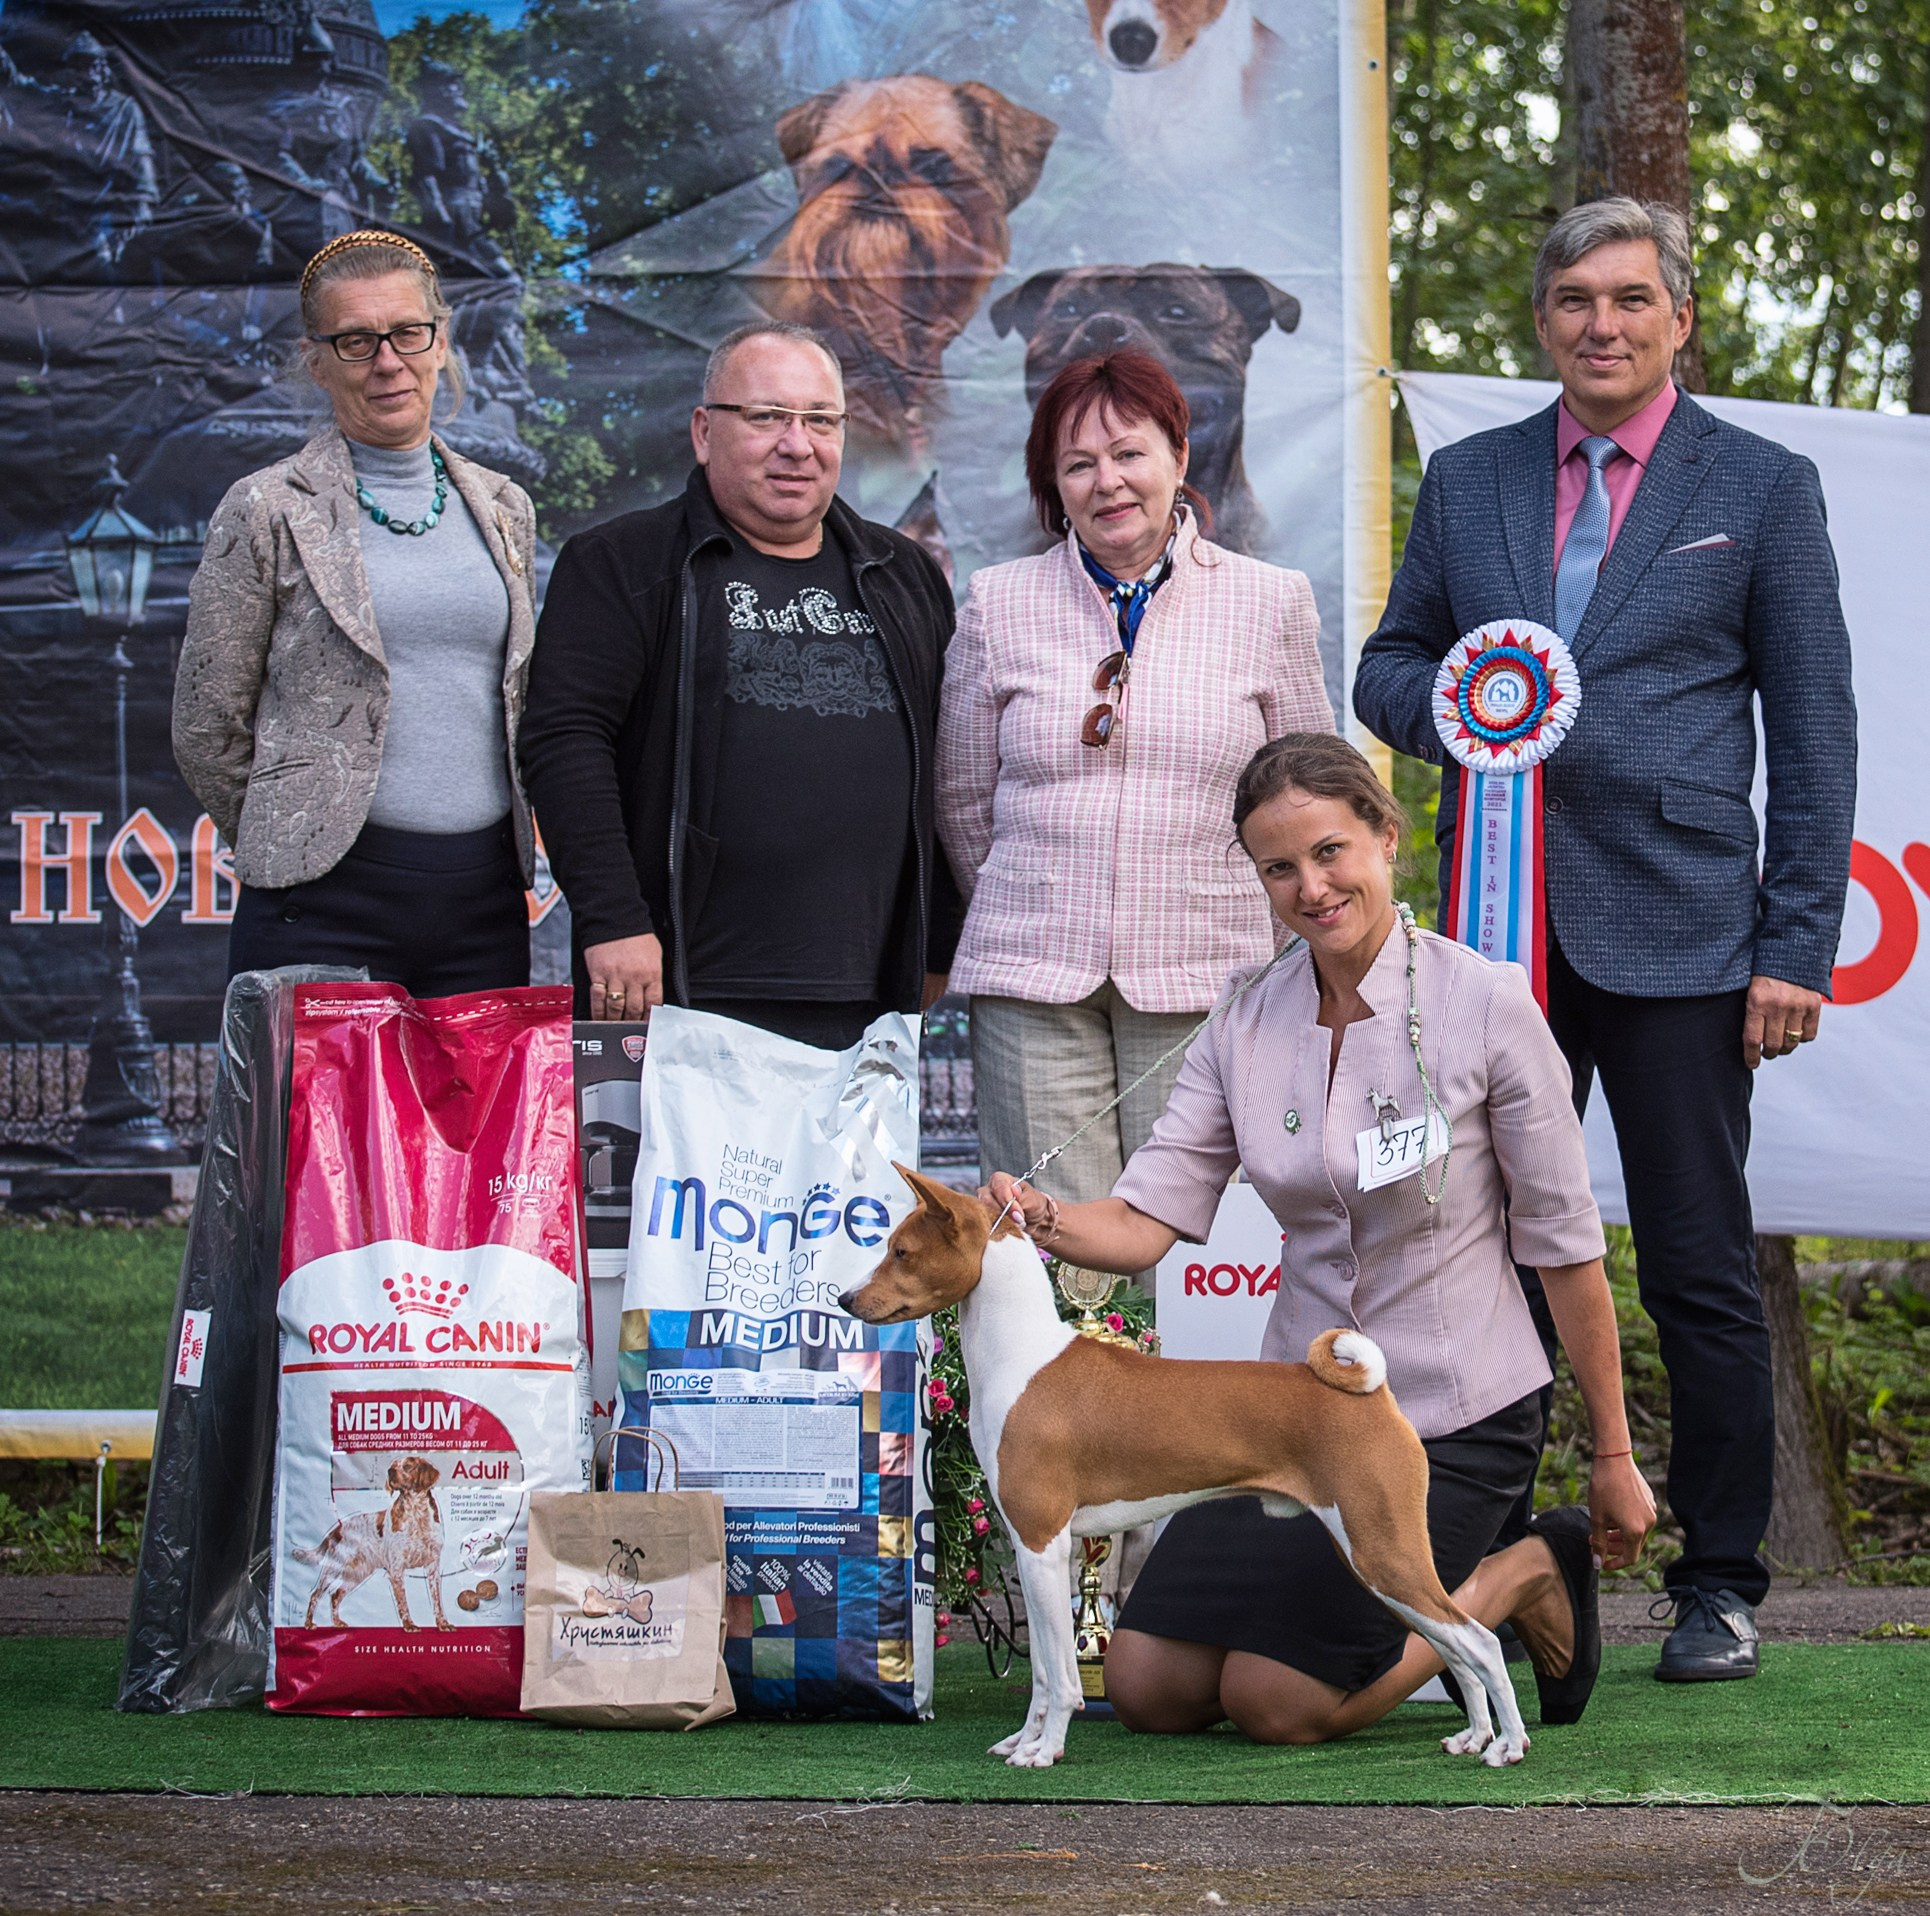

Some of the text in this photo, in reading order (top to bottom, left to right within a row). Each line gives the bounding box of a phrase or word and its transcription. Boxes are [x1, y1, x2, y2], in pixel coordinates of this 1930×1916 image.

[1488, 819, 1497, 865] BEST
[1482, 903, 1495, 953] SHOW
[723, 1143, 783, 1175] Natural
[1377, 1125, 1426, 1166] 377
[488, 1174, 503, 1196] 15
[720, 1160, 774, 1189] Super
[719, 1176, 794, 1209] Premium
[708, 1241, 822, 1286] Best for
[705, 1271, 842, 1313] Breeders
[1184, 1263, 1282, 1297] ROYA
[308, 1320, 541, 1355] ROYAL CANIN
[700, 1312, 864, 1351] MEDIUM
[179, 1318, 194, 1377] ROYAL CANIN
[337, 1401, 461, 1431] MEDIUM
[348, 1433, 369, 1441] MEDIUM
[350, 1441, 367, 1449] СОБАК
[368, 1441, 394, 1449] СРЕДНИХ
[463, 1441, 471, 1449] ДО
[451, 1460, 510, 1479] Adult
[736, 1522, 754, 1532] per
[753, 1521, 797, 1531] Allevatori
[798, 1522, 861, 1532] Professionisti
[744, 1534, 802, 1544] Professional
[803, 1535, 846, 1544] Breeders
[731, 1562, 745, 1576] free
[732, 1554, 753, 1576] cruelty
[760, 1561, 787, 1591] Italian
[770, 1558, 792, 1582] 100%
[802, 1558, 834, 1593] la vendita
[812, 1559, 833, 1582] vietata
[756, 1570, 779, 1593] product
[801, 1570, 828, 1597] dettaglio
[559, 1616, 673, 1648] Хрустяшкин
[431, 1645, 491, 1653] NUTRITION
